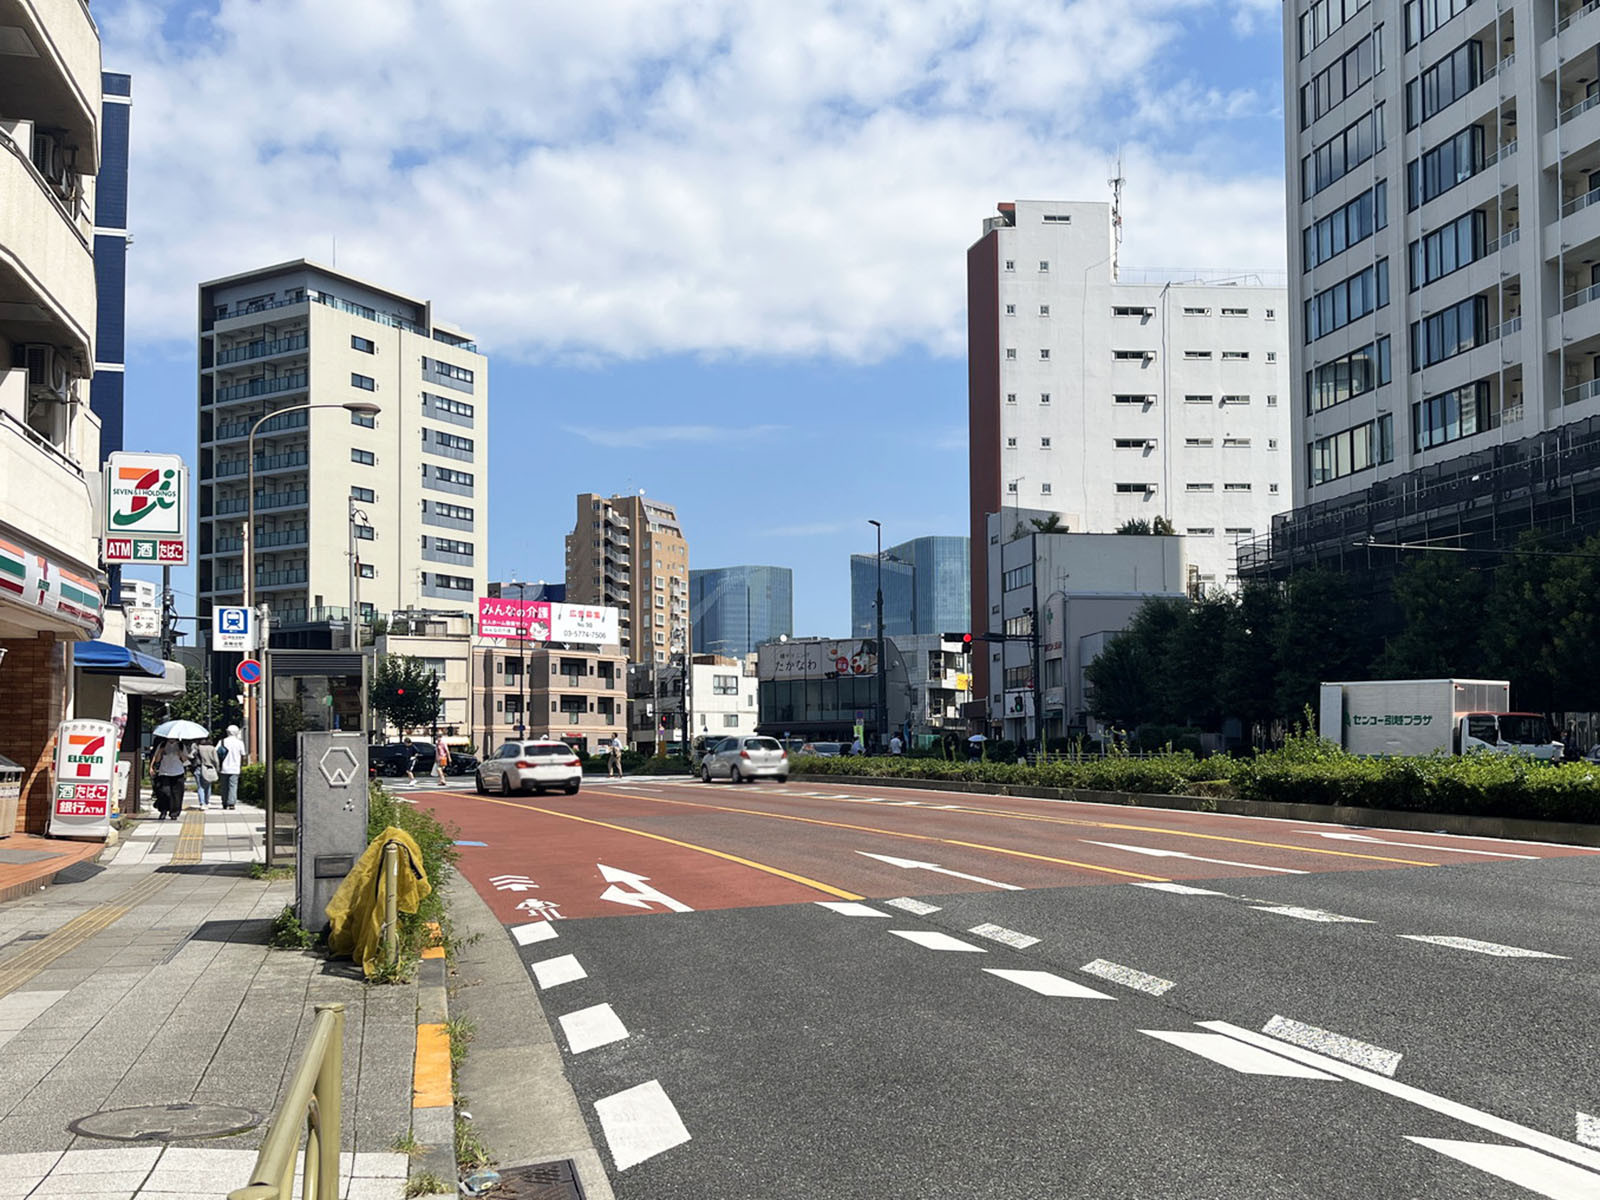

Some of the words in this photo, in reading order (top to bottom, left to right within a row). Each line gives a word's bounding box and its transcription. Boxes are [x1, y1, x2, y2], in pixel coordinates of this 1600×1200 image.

[143, 489, 176, 497] HOLDINGS
[108, 542, 131, 556] ATM
[137, 542, 153, 557] 酒
[160, 543, 183, 558] たばこ
[775, 658, 817, 672] たかなわ
[1353, 714, 1432, 726] センコー引越プラザ
[59, 785, 74, 799] 酒
[76, 786, 107, 799] たばこ
[59, 801, 104, 813] 銀行ATM
